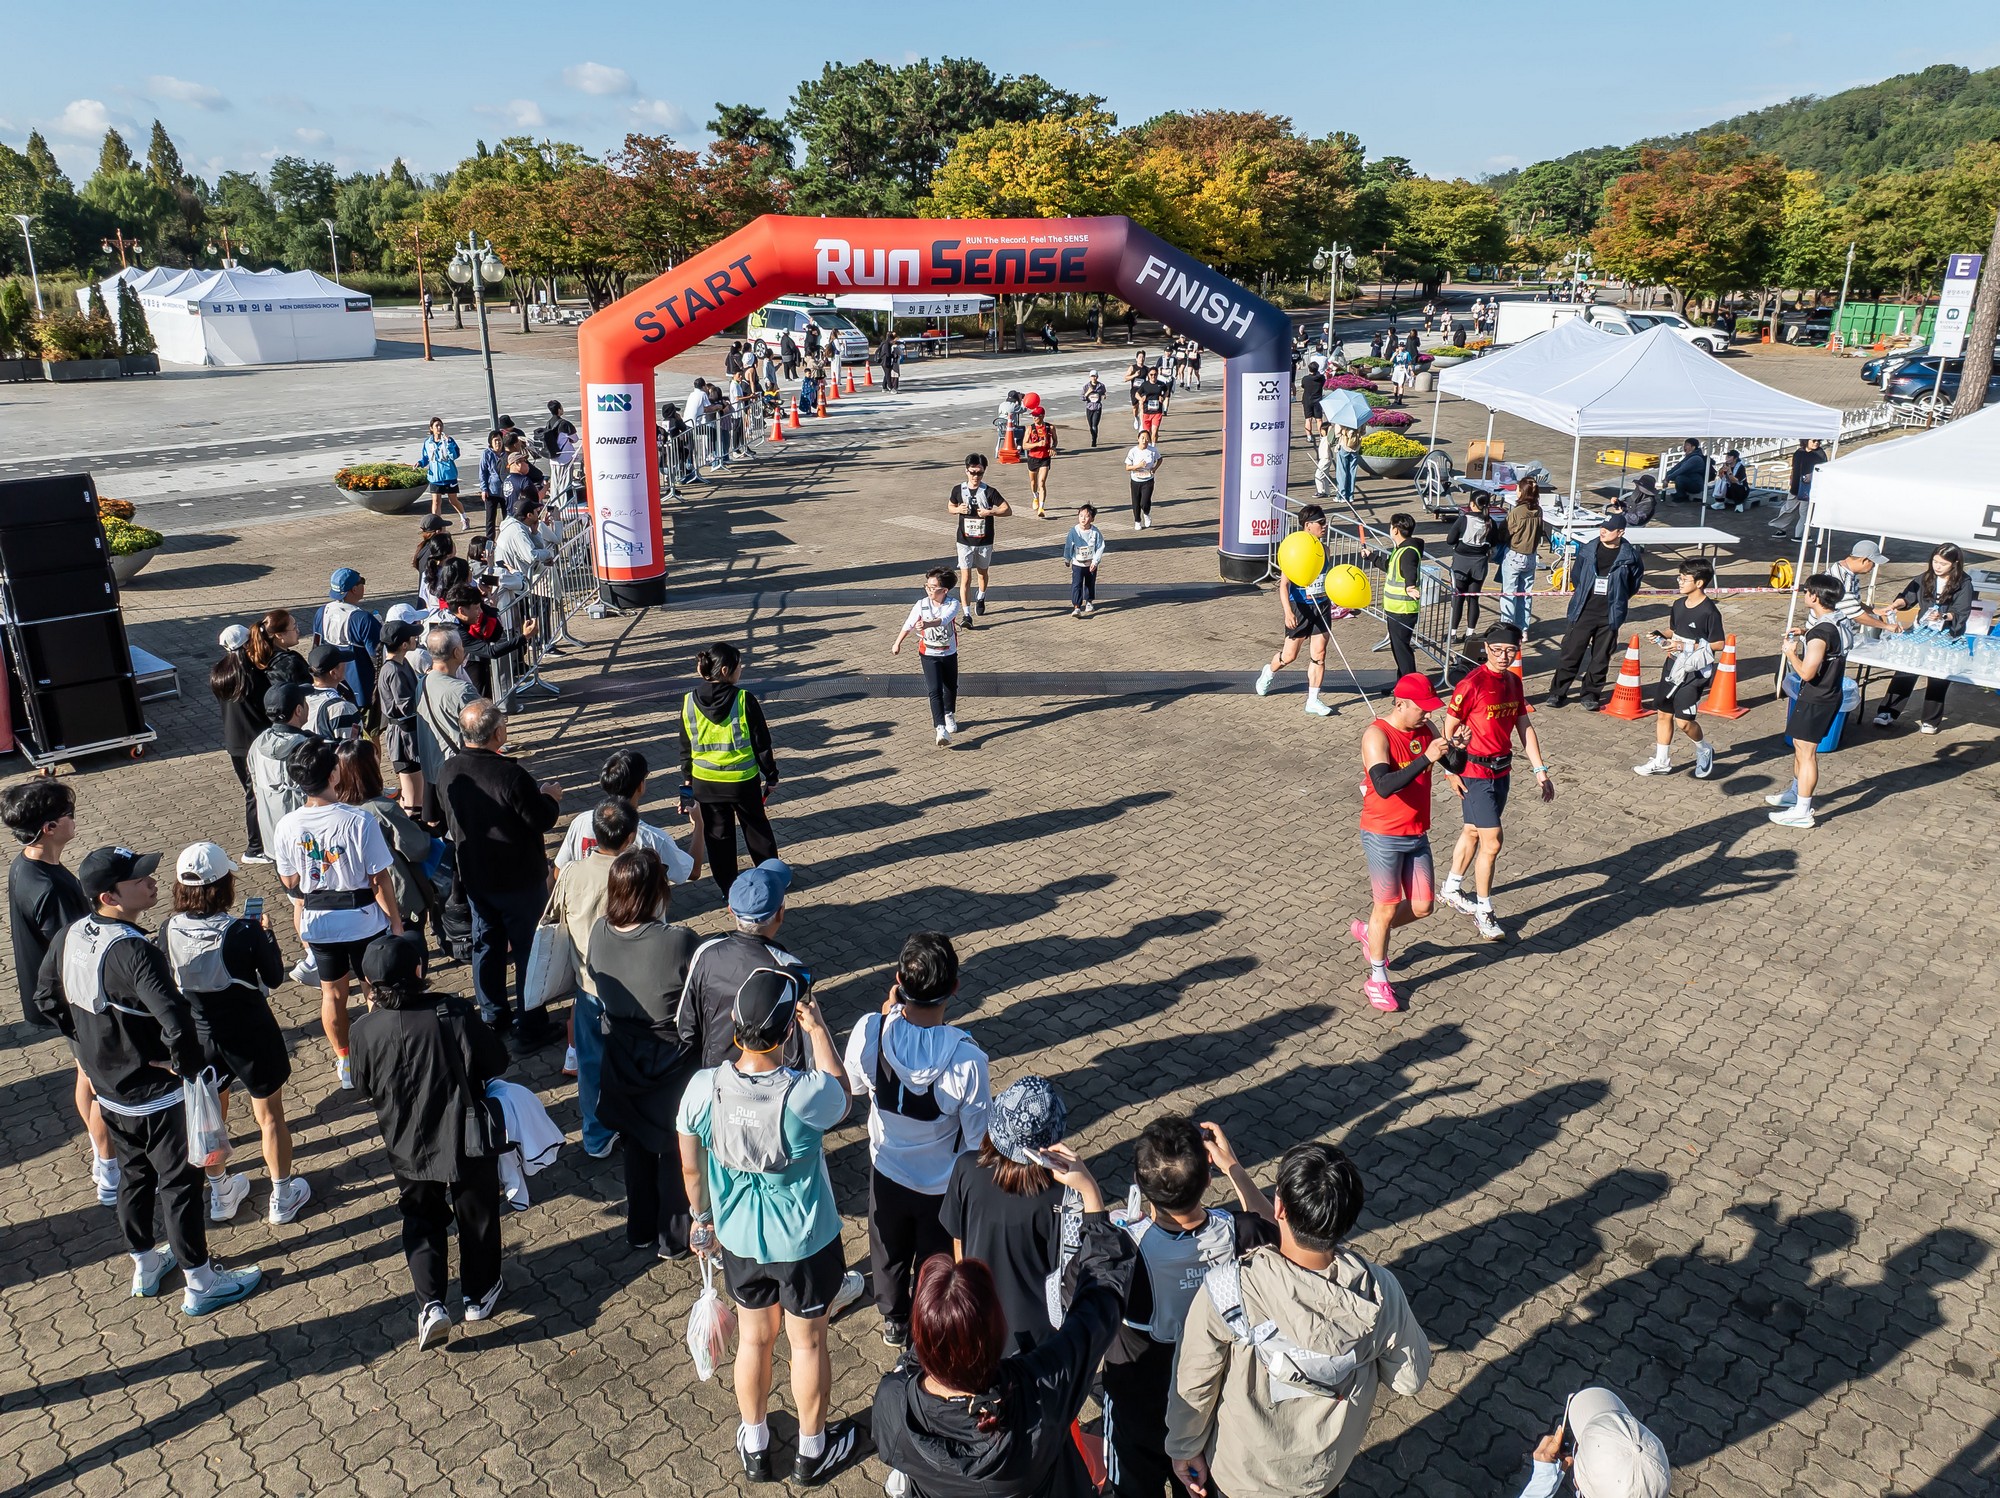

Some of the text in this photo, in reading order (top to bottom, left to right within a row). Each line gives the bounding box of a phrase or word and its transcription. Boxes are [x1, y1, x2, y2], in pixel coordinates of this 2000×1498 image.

[965, 234, 1089, 245] RUN The Record, Feel The SENSE
[1955, 258, 1972, 277] E
[634, 254, 758, 343] START
[1135, 254, 1255, 339] FINISH
[212, 303, 273, 313] 남자탈의실
[595, 436, 638, 445] JOHNBER
[1266, 453, 1284, 461] Short
[605, 472, 641, 480] FLIPBELT
[735, 1105, 757, 1119] Run
